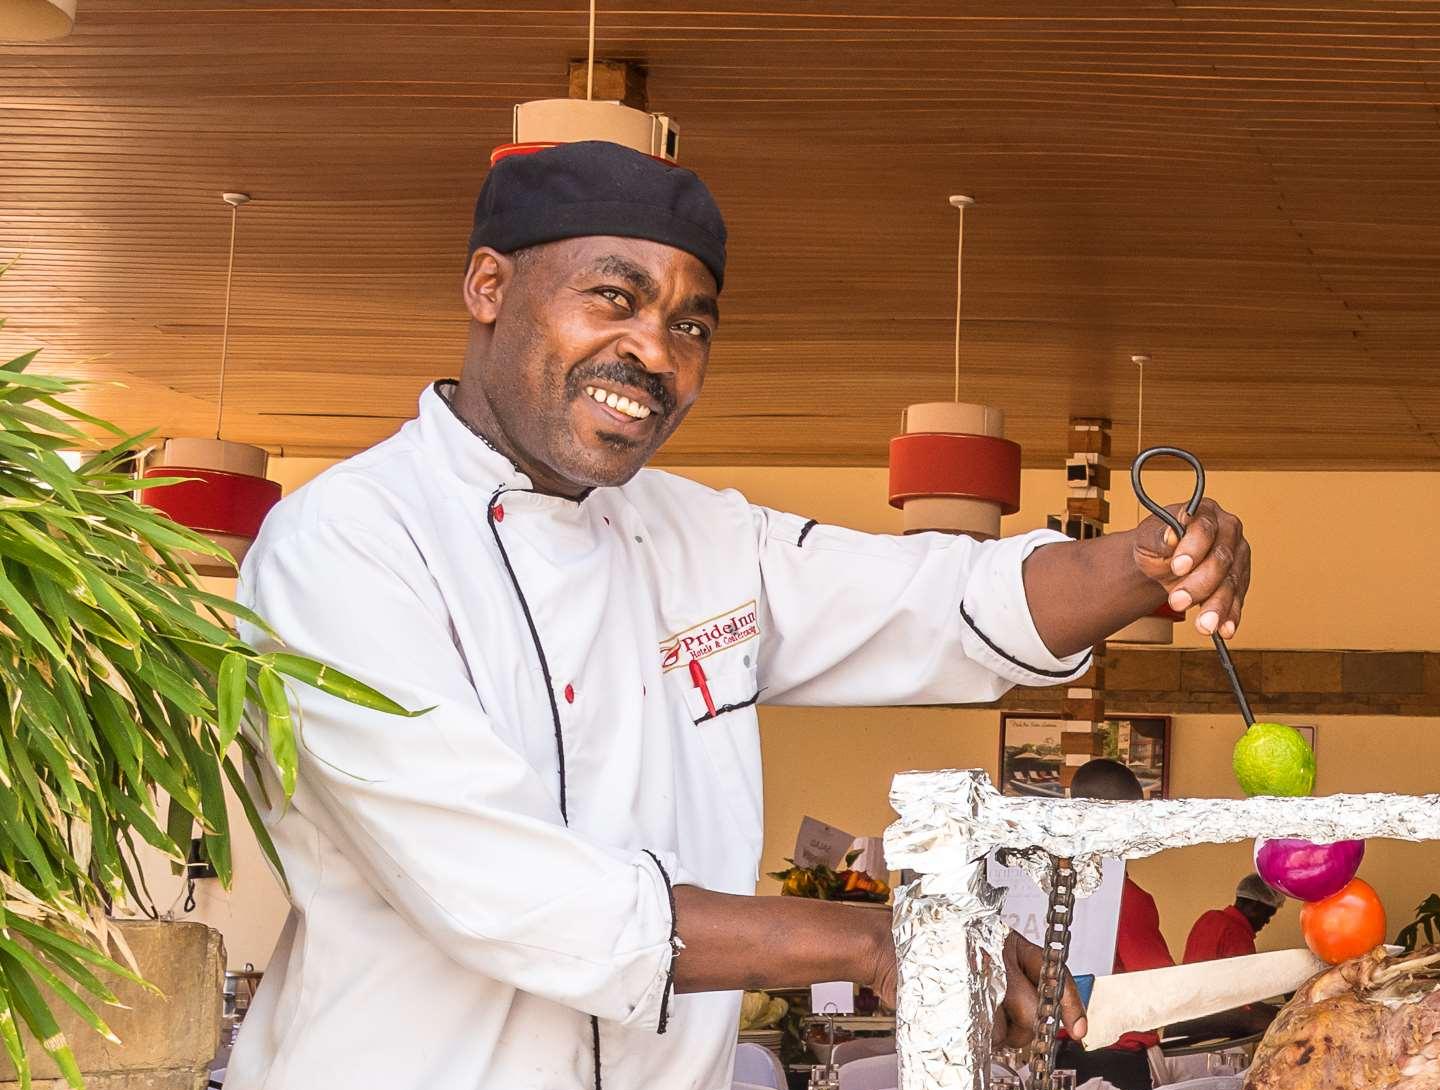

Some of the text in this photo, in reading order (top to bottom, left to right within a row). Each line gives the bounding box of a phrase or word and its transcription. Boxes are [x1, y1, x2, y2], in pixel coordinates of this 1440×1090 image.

[681, 611, 755, 651] PrideInn
[690, 644, 713, 658] Hotels
[714, 640, 722, 649] &
